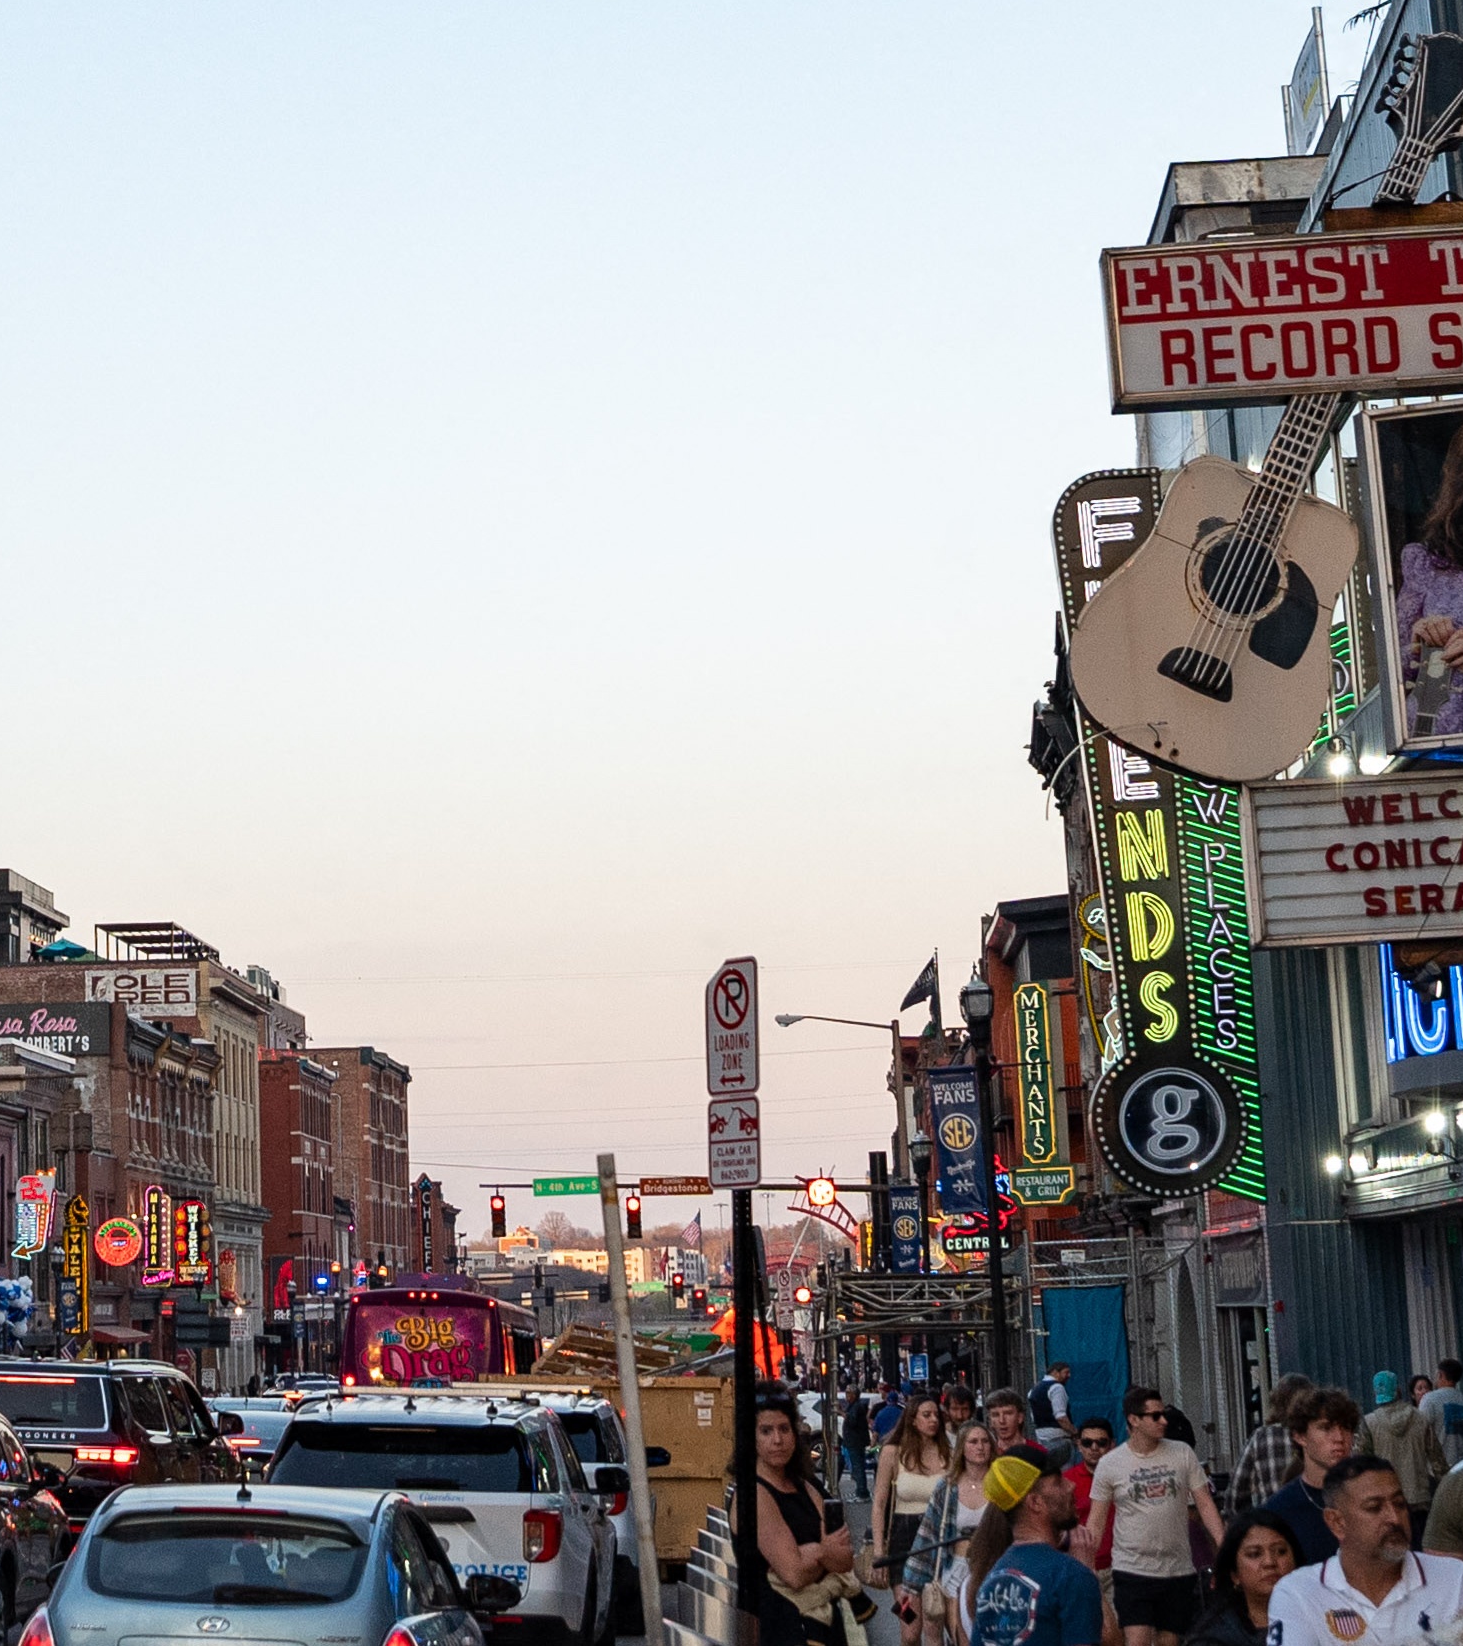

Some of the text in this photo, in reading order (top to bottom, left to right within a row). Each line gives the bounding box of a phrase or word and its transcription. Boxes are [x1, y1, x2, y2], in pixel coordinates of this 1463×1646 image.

[1117, 243, 1391, 318] ERNEST
[1159, 315, 1401, 387] RECORD
[1075, 495, 1179, 1046] FENDS
[1204, 842, 1239, 1051] PLACES
[113, 973, 191, 991] OLE
[114, 990, 191, 1005] RED
[29, 1006, 79, 1034] Rosa
[713, 1032, 750, 1053] LOADING
[721, 1053, 744, 1072] ZONE
[1020, 991, 1047, 1157] MERCHANTS
[931, 1081, 974, 1092] WELCOME
[934, 1090, 976, 1105] FANS
[1146, 1083, 1201, 1161] g
[942, 1120, 973, 1144] SEC
[738, 1145, 752, 1156] CAR
[549, 1181, 564, 1192] 4th
[643, 1183, 699, 1195] Bridgestone
[1016, 1173, 1070, 1187] RESTAURANT
[1037, 1183, 1062, 1198] GRILL
[892, 1201, 918, 1211] FANS
[149, 1193, 158, 1265] MIRANDA
[187, 1205, 199, 1266] WHISKEY
[896, 1219, 915, 1236] SEC
[945, 1235, 1009, 1251] CENTRL
[394, 1315, 457, 1352] Big
[360, 1340, 476, 1389] Drag
[17, 1430, 77, 1440] AGONEER
[452, 1563, 528, 1581] POLICE
